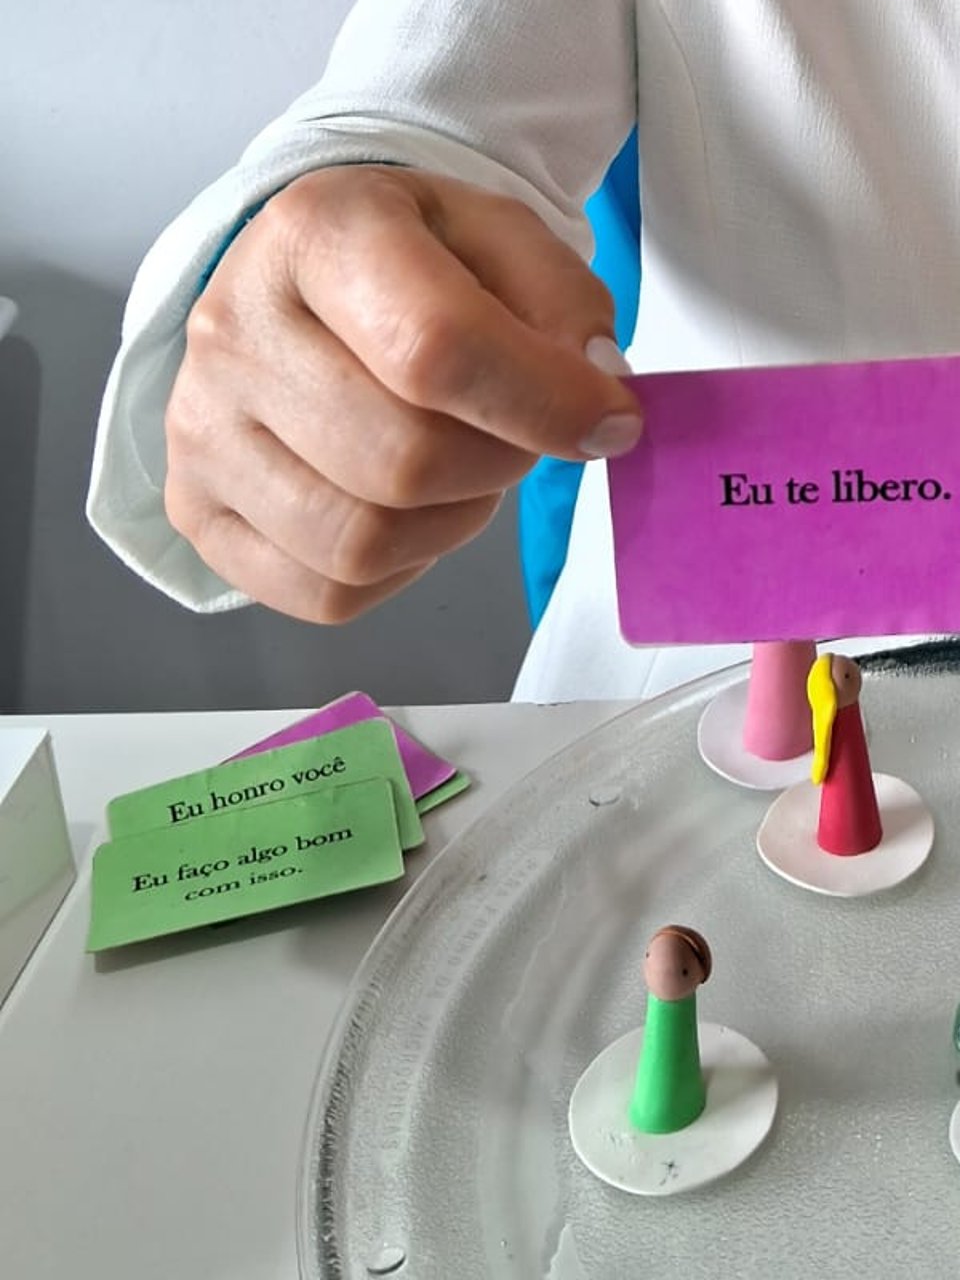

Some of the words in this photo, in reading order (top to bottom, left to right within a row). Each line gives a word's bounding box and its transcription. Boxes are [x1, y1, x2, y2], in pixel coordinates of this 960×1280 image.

[719, 474, 774, 506] Eu
[786, 477, 820, 505] te
[832, 470, 952, 503] libero.
[167, 801, 205, 824] Eu
[210, 779, 285, 811] honro
[292, 756, 347, 785] você
[132, 874, 169, 892] Eu
[177, 858, 230, 881] faço
[237, 846, 289, 866] algo
[296, 828, 353, 851] bom
[184, 881, 241, 902] com
[249, 867, 304, 886] isso.
